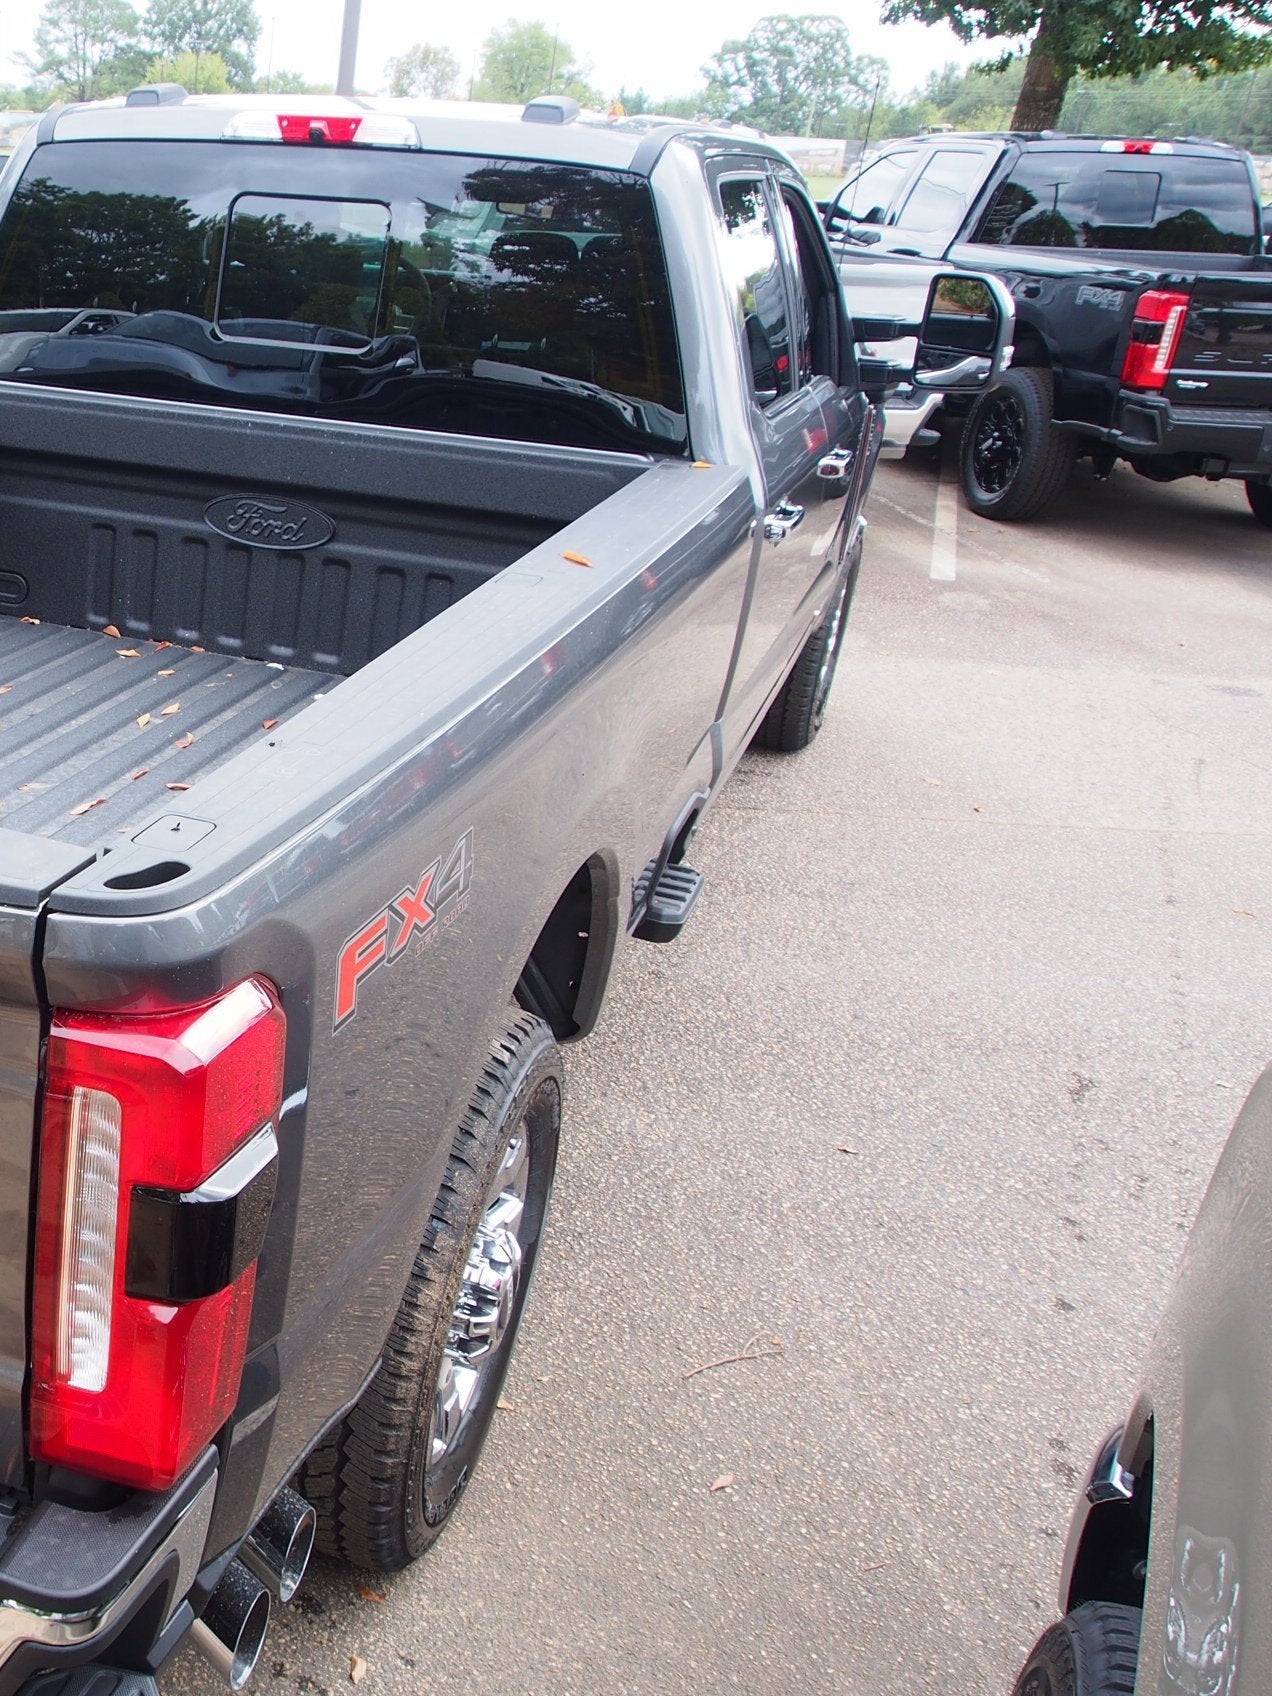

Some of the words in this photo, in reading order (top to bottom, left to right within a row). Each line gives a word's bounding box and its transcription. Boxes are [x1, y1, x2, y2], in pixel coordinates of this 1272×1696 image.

[1074, 285, 1127, 306] FX4
[226, 499, 308, 542] Ford
[332, 826, 474, 1037] FX4
